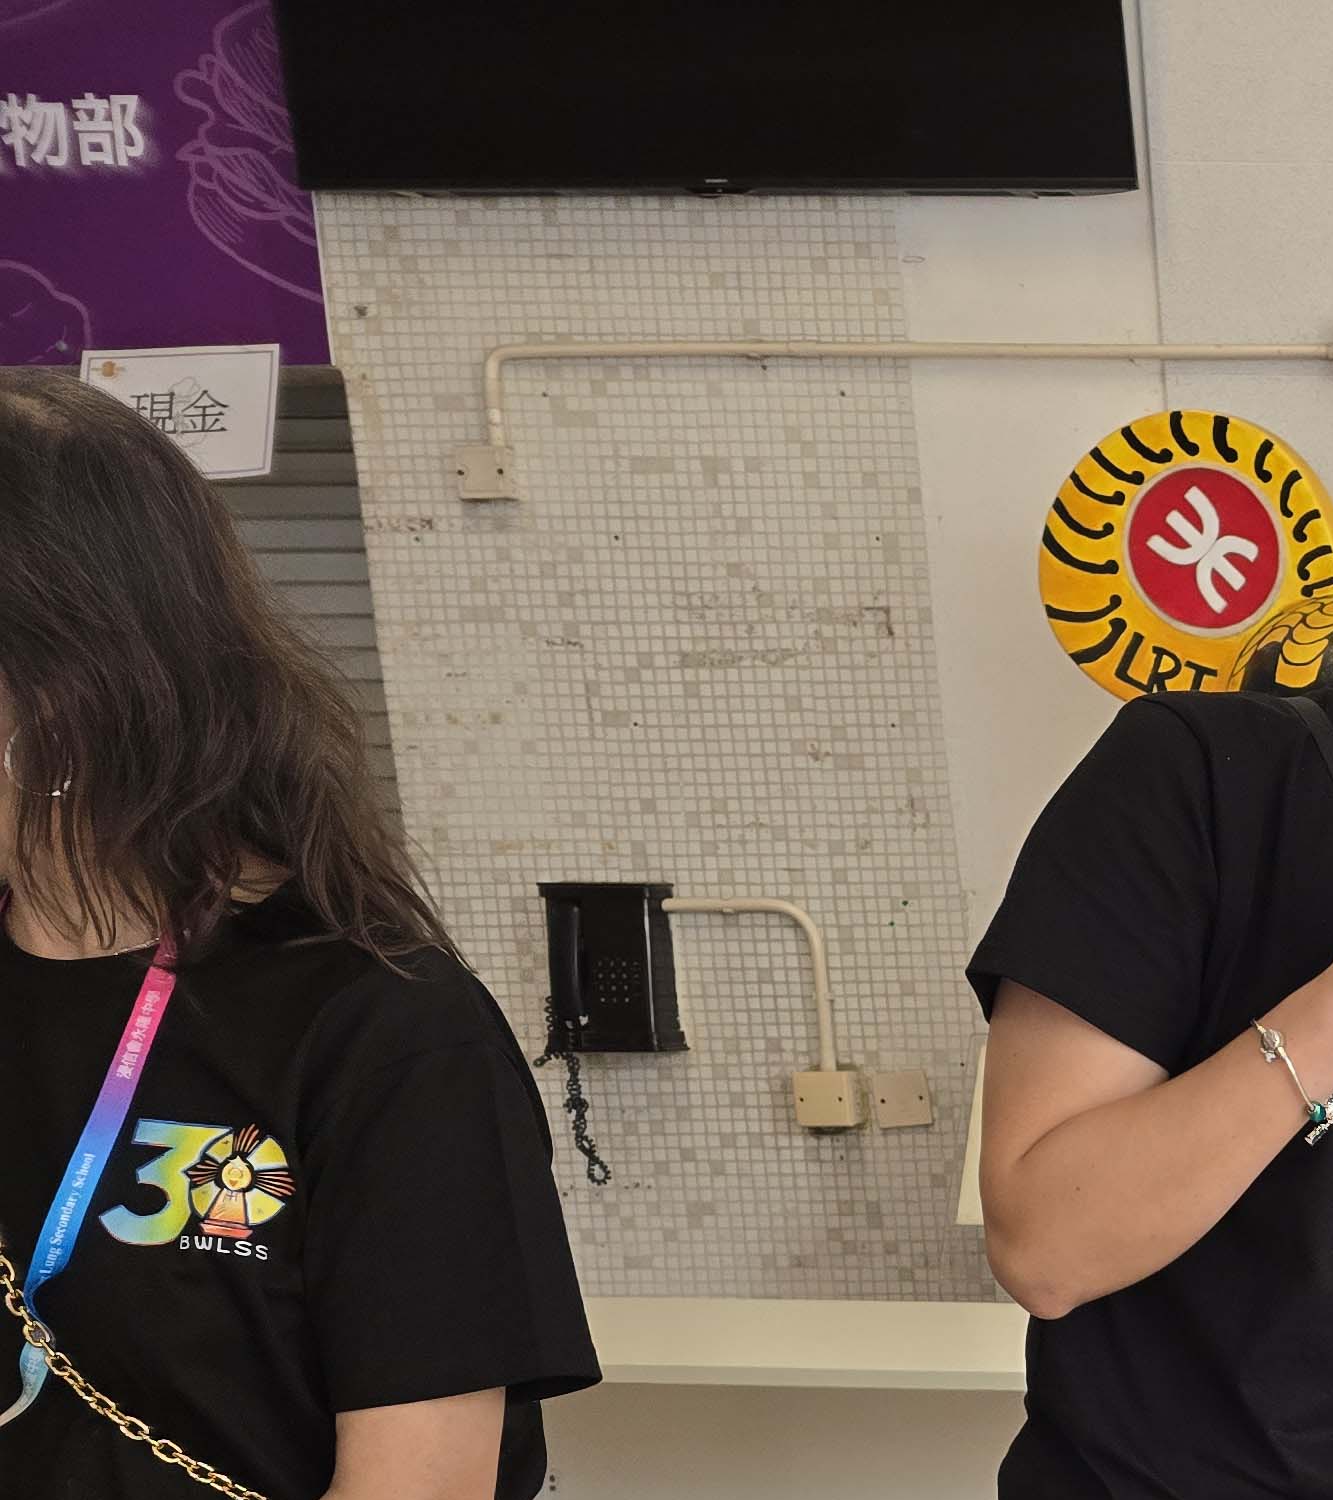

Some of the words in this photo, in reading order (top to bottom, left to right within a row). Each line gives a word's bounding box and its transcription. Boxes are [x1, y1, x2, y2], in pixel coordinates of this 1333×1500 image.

[130, 389, 229, 434] 現金
[1114, 631, 1218, 693] LRT
[70, 1151, 95, 1190] School
[49, 1188, 82, 1247] Secondary
[39, 1245, 61, 1276] Lung
[180, 1235, 269, 1261] BWLSS
